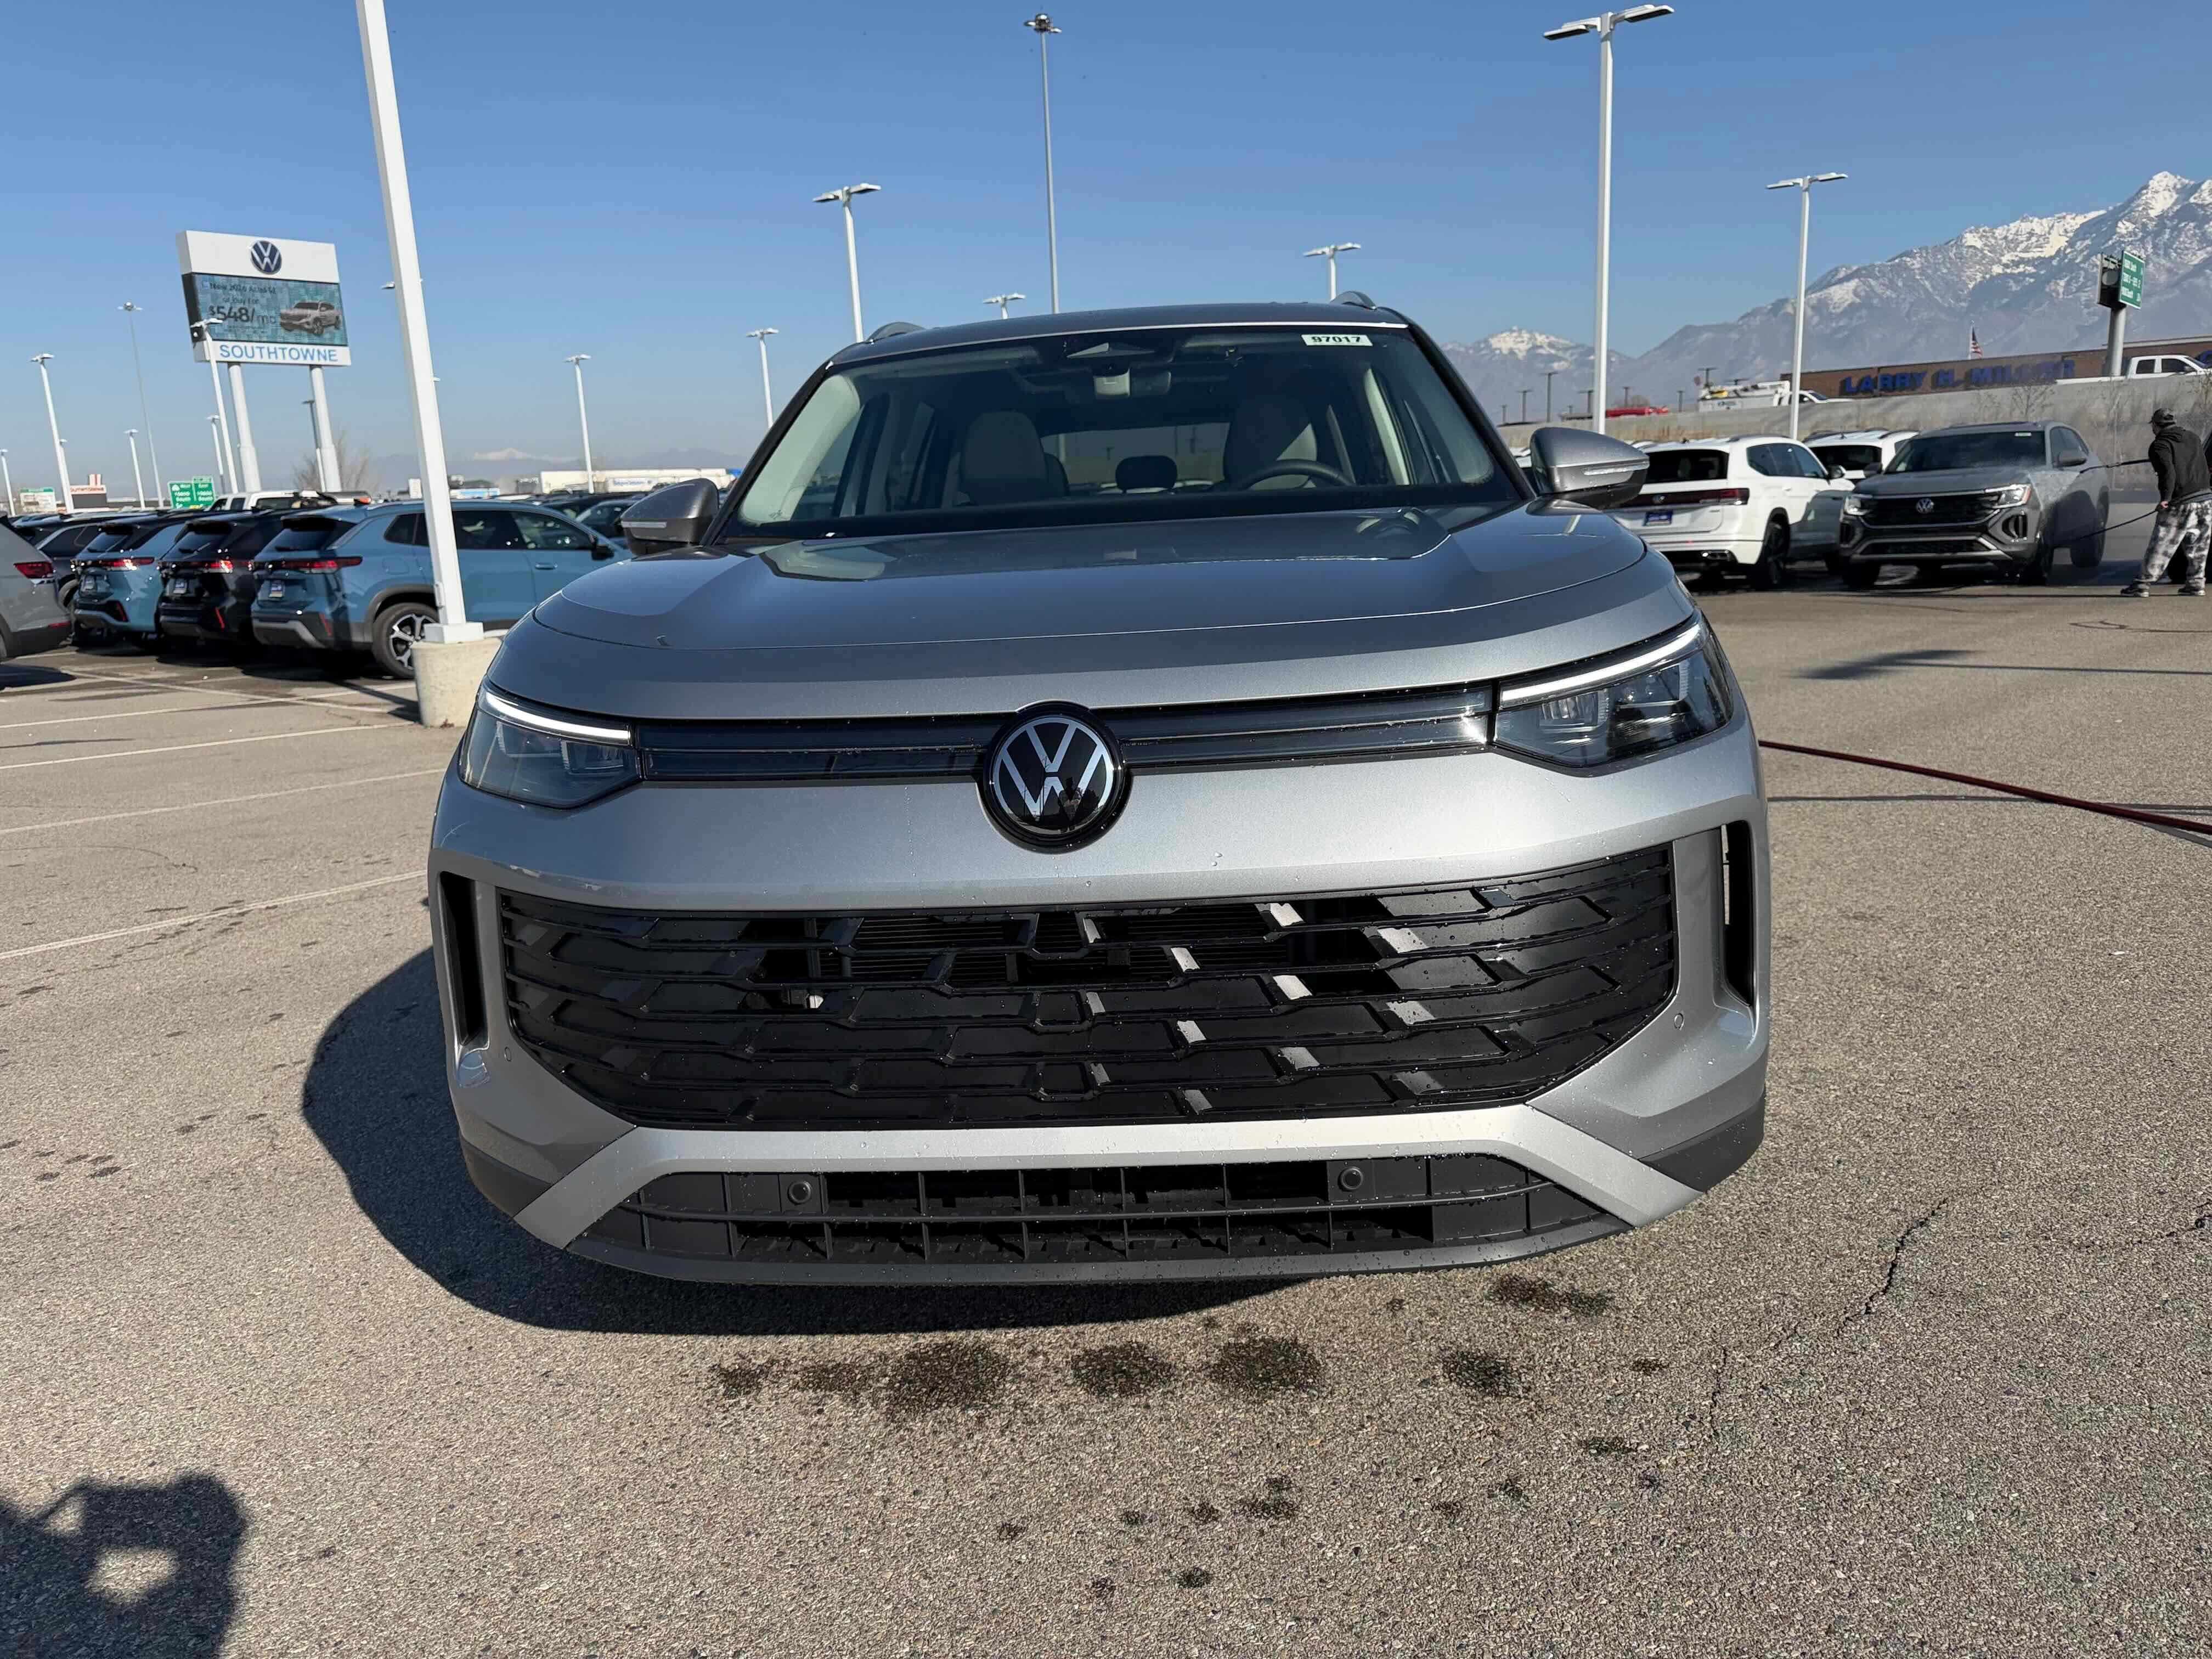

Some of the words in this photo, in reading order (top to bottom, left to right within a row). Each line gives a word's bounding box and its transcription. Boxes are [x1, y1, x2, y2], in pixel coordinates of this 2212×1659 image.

[219, 344, 338, 362] SOUTHTOWNE
[1844, 371, 1927, 394] LARRY
[992, 716, 1114, 835] VW
